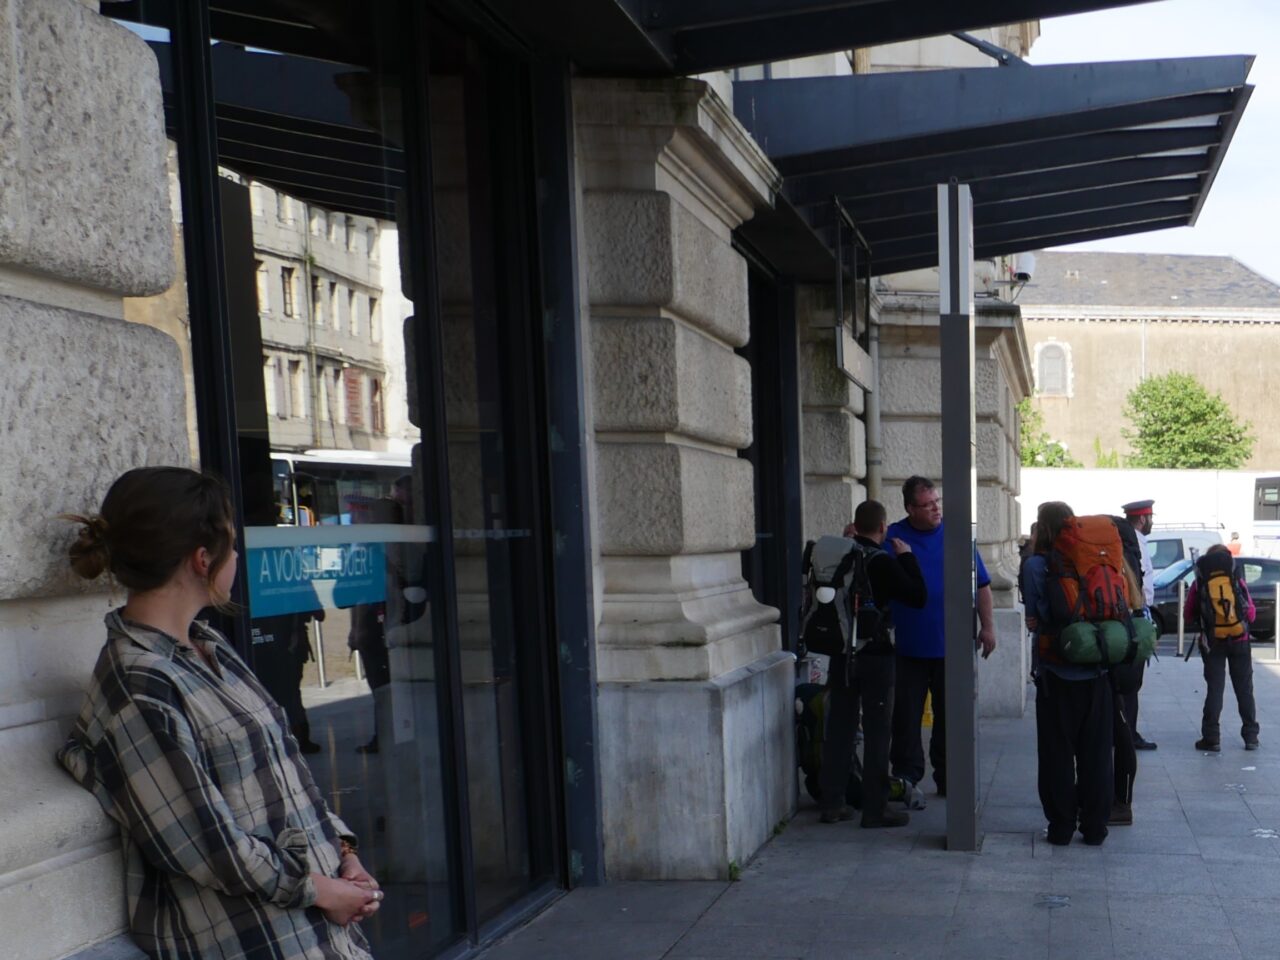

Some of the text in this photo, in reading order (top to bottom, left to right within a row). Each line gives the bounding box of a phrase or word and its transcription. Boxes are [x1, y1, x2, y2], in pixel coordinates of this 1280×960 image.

[260, 550, 272, 583] A
[273, 547, 310, 582] VOUS
[331, 545, 368, 578] OUER
